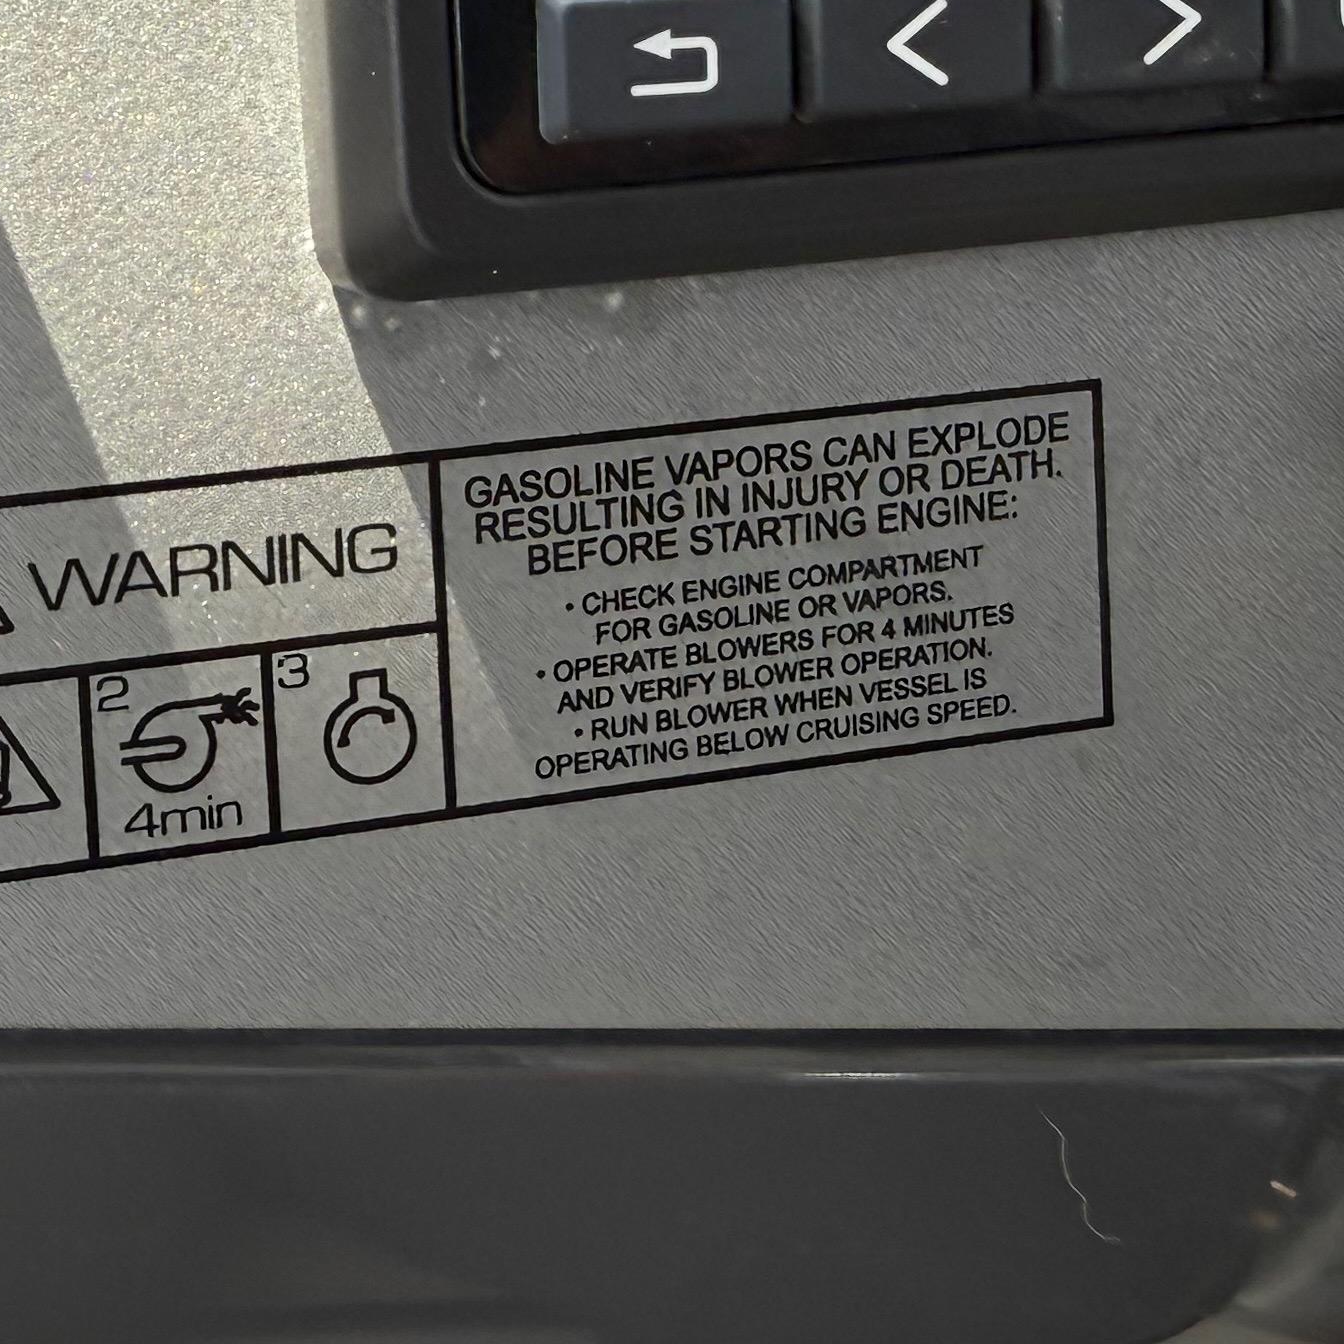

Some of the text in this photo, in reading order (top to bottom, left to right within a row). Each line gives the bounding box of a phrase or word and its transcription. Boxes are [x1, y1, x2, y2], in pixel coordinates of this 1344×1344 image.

[463, 412, 1070, 508] GASOLINE VAPORS CAN EXPLODE
[475, 449, 1062, 544] RESULTING IN INJURY OR DEATH.
[28, 523, 398, 612] WARNING
[527, 490, 1018, 576] BEFORE STARTING ENGINE:
[582, 545, 983, 615] CHECK ENGINE COMPARTMENT
[595, 580, 952, 644] FOR GASOLINE OR VAPORS.
[278, 653, 310, 689] 3
[554, 603, 1014, 683] OPERATE BLOWERS FOR 4 MINUTES
[557, 637, 992, 713] AND VERIFY BLOWER OPERATION.
[96, 675, 130, 712] 2
[591, 667, 986, 742] RUN BLOWER WHEN VESSEL IS
[534, 694, 1016, 779] OPERATING BELOW CRUISING SPEED.
[124, 795, 243, 837] 4min
